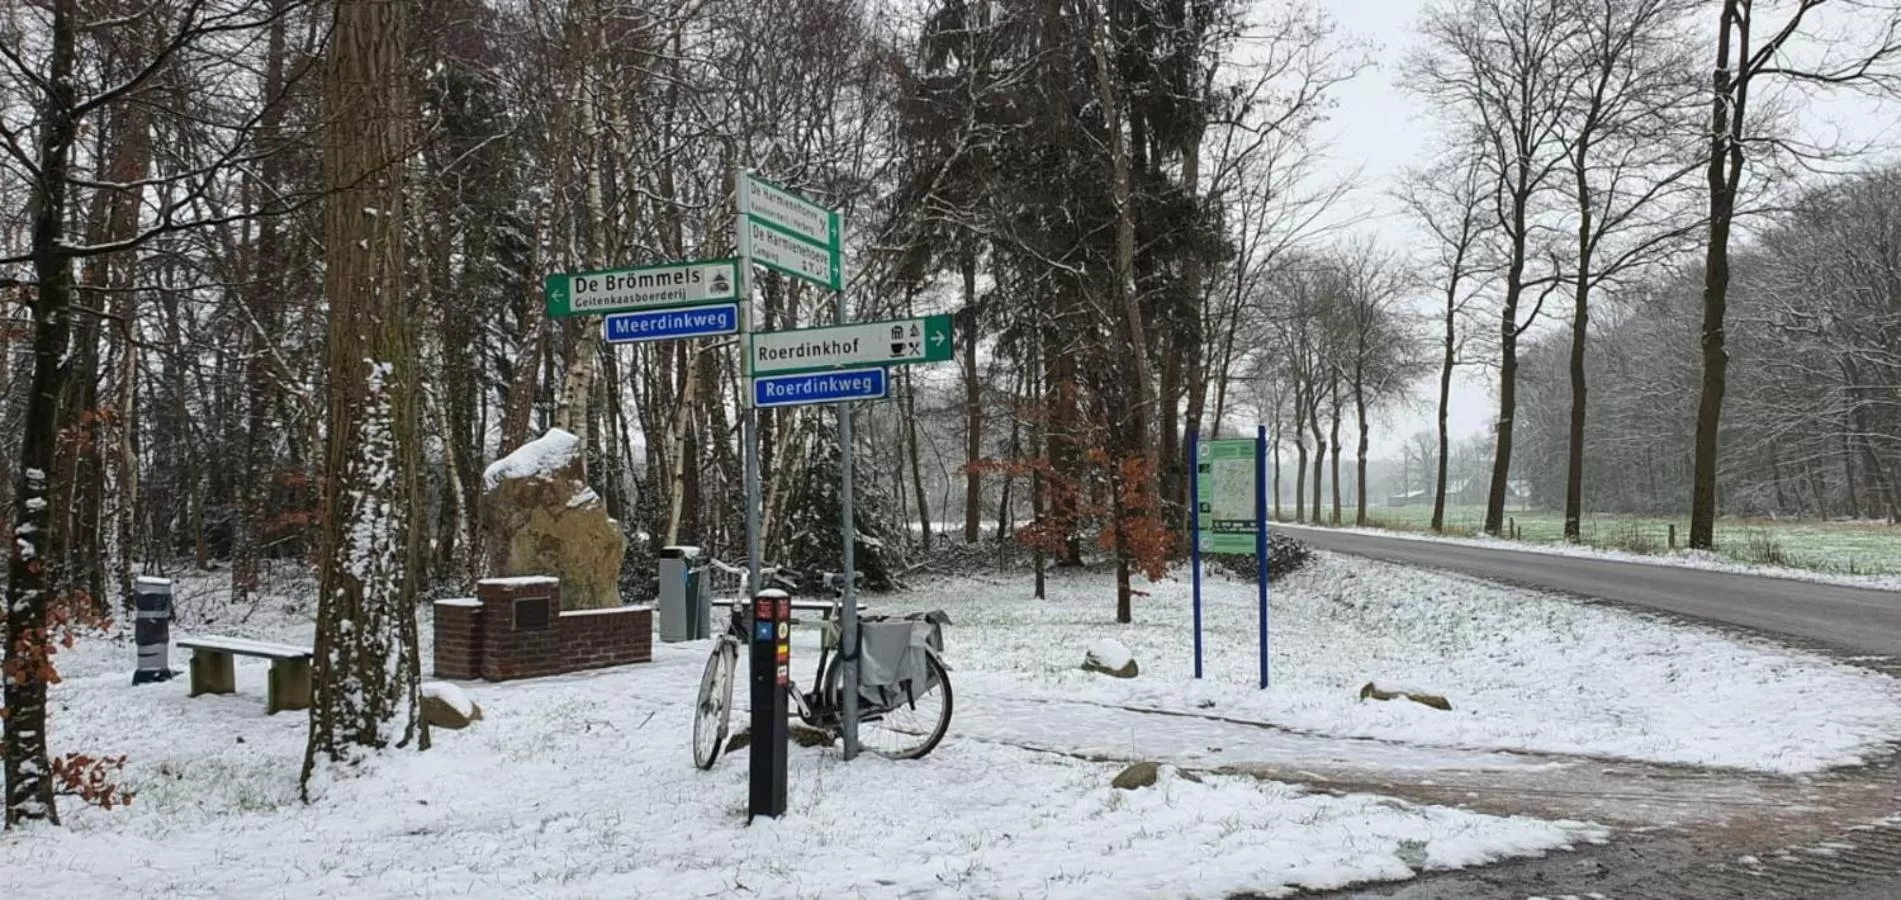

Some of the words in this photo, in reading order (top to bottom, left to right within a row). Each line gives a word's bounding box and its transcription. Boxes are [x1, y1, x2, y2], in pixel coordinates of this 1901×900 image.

[753, 223, 765, 240] De
[575, 277, 599, 294] De
[606, 268, 700, 291] Brömmels
[575, 288, 687, 308] Geitenkaasboerderij
[616, 313, 727, 333] Meerdinkweg
[759, 338, 860, 361] Roerdinkhof
[766, 377, 872, 397] Roerdinkweg
